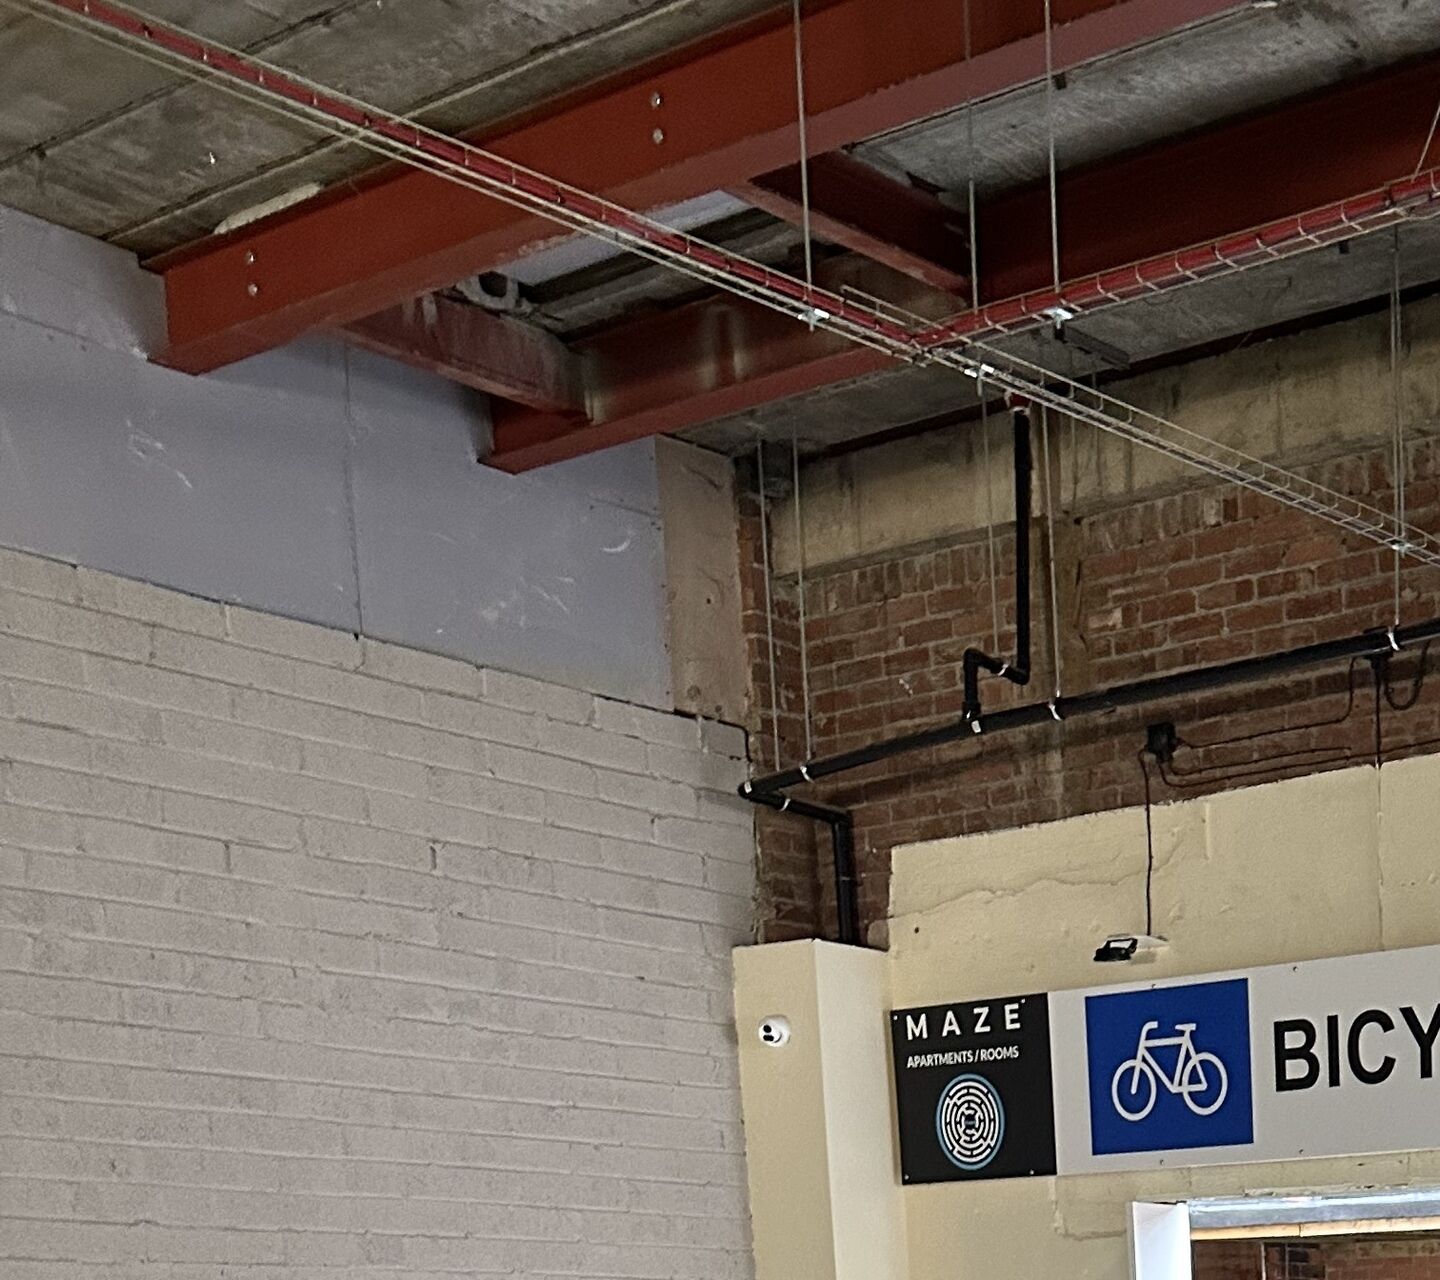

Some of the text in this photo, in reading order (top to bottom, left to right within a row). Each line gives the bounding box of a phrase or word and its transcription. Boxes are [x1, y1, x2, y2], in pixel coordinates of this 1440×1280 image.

[906, 1003, 1021, 1041] MAZE
[907, 1050, 973, 1068] APARTMENTS
[980, 1046, 1019, 1061] ROOMS
